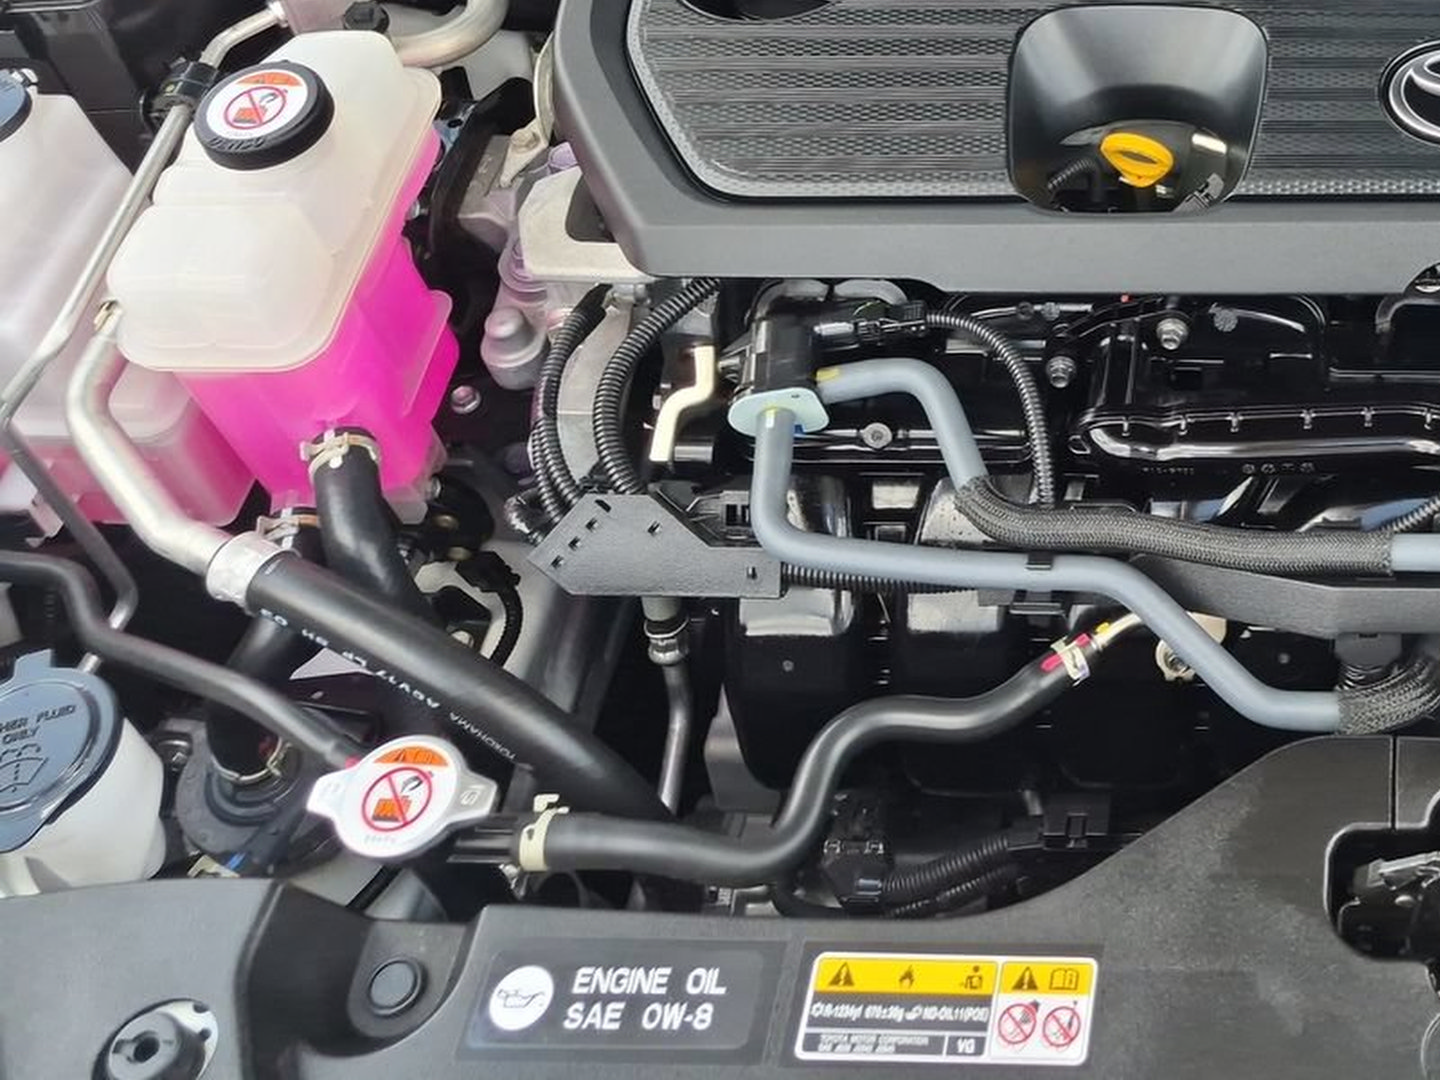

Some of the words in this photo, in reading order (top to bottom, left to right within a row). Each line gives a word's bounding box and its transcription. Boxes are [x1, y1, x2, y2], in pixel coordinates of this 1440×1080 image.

[449, 711, 517, 760] YOKOHAMA
[571, 966, 673, 995] ENGINE
[685, 967, 728, 995] OIL
[562, 1002, 627, 1030] SAE
[641, 1002, 715, 1030] 0W-8
